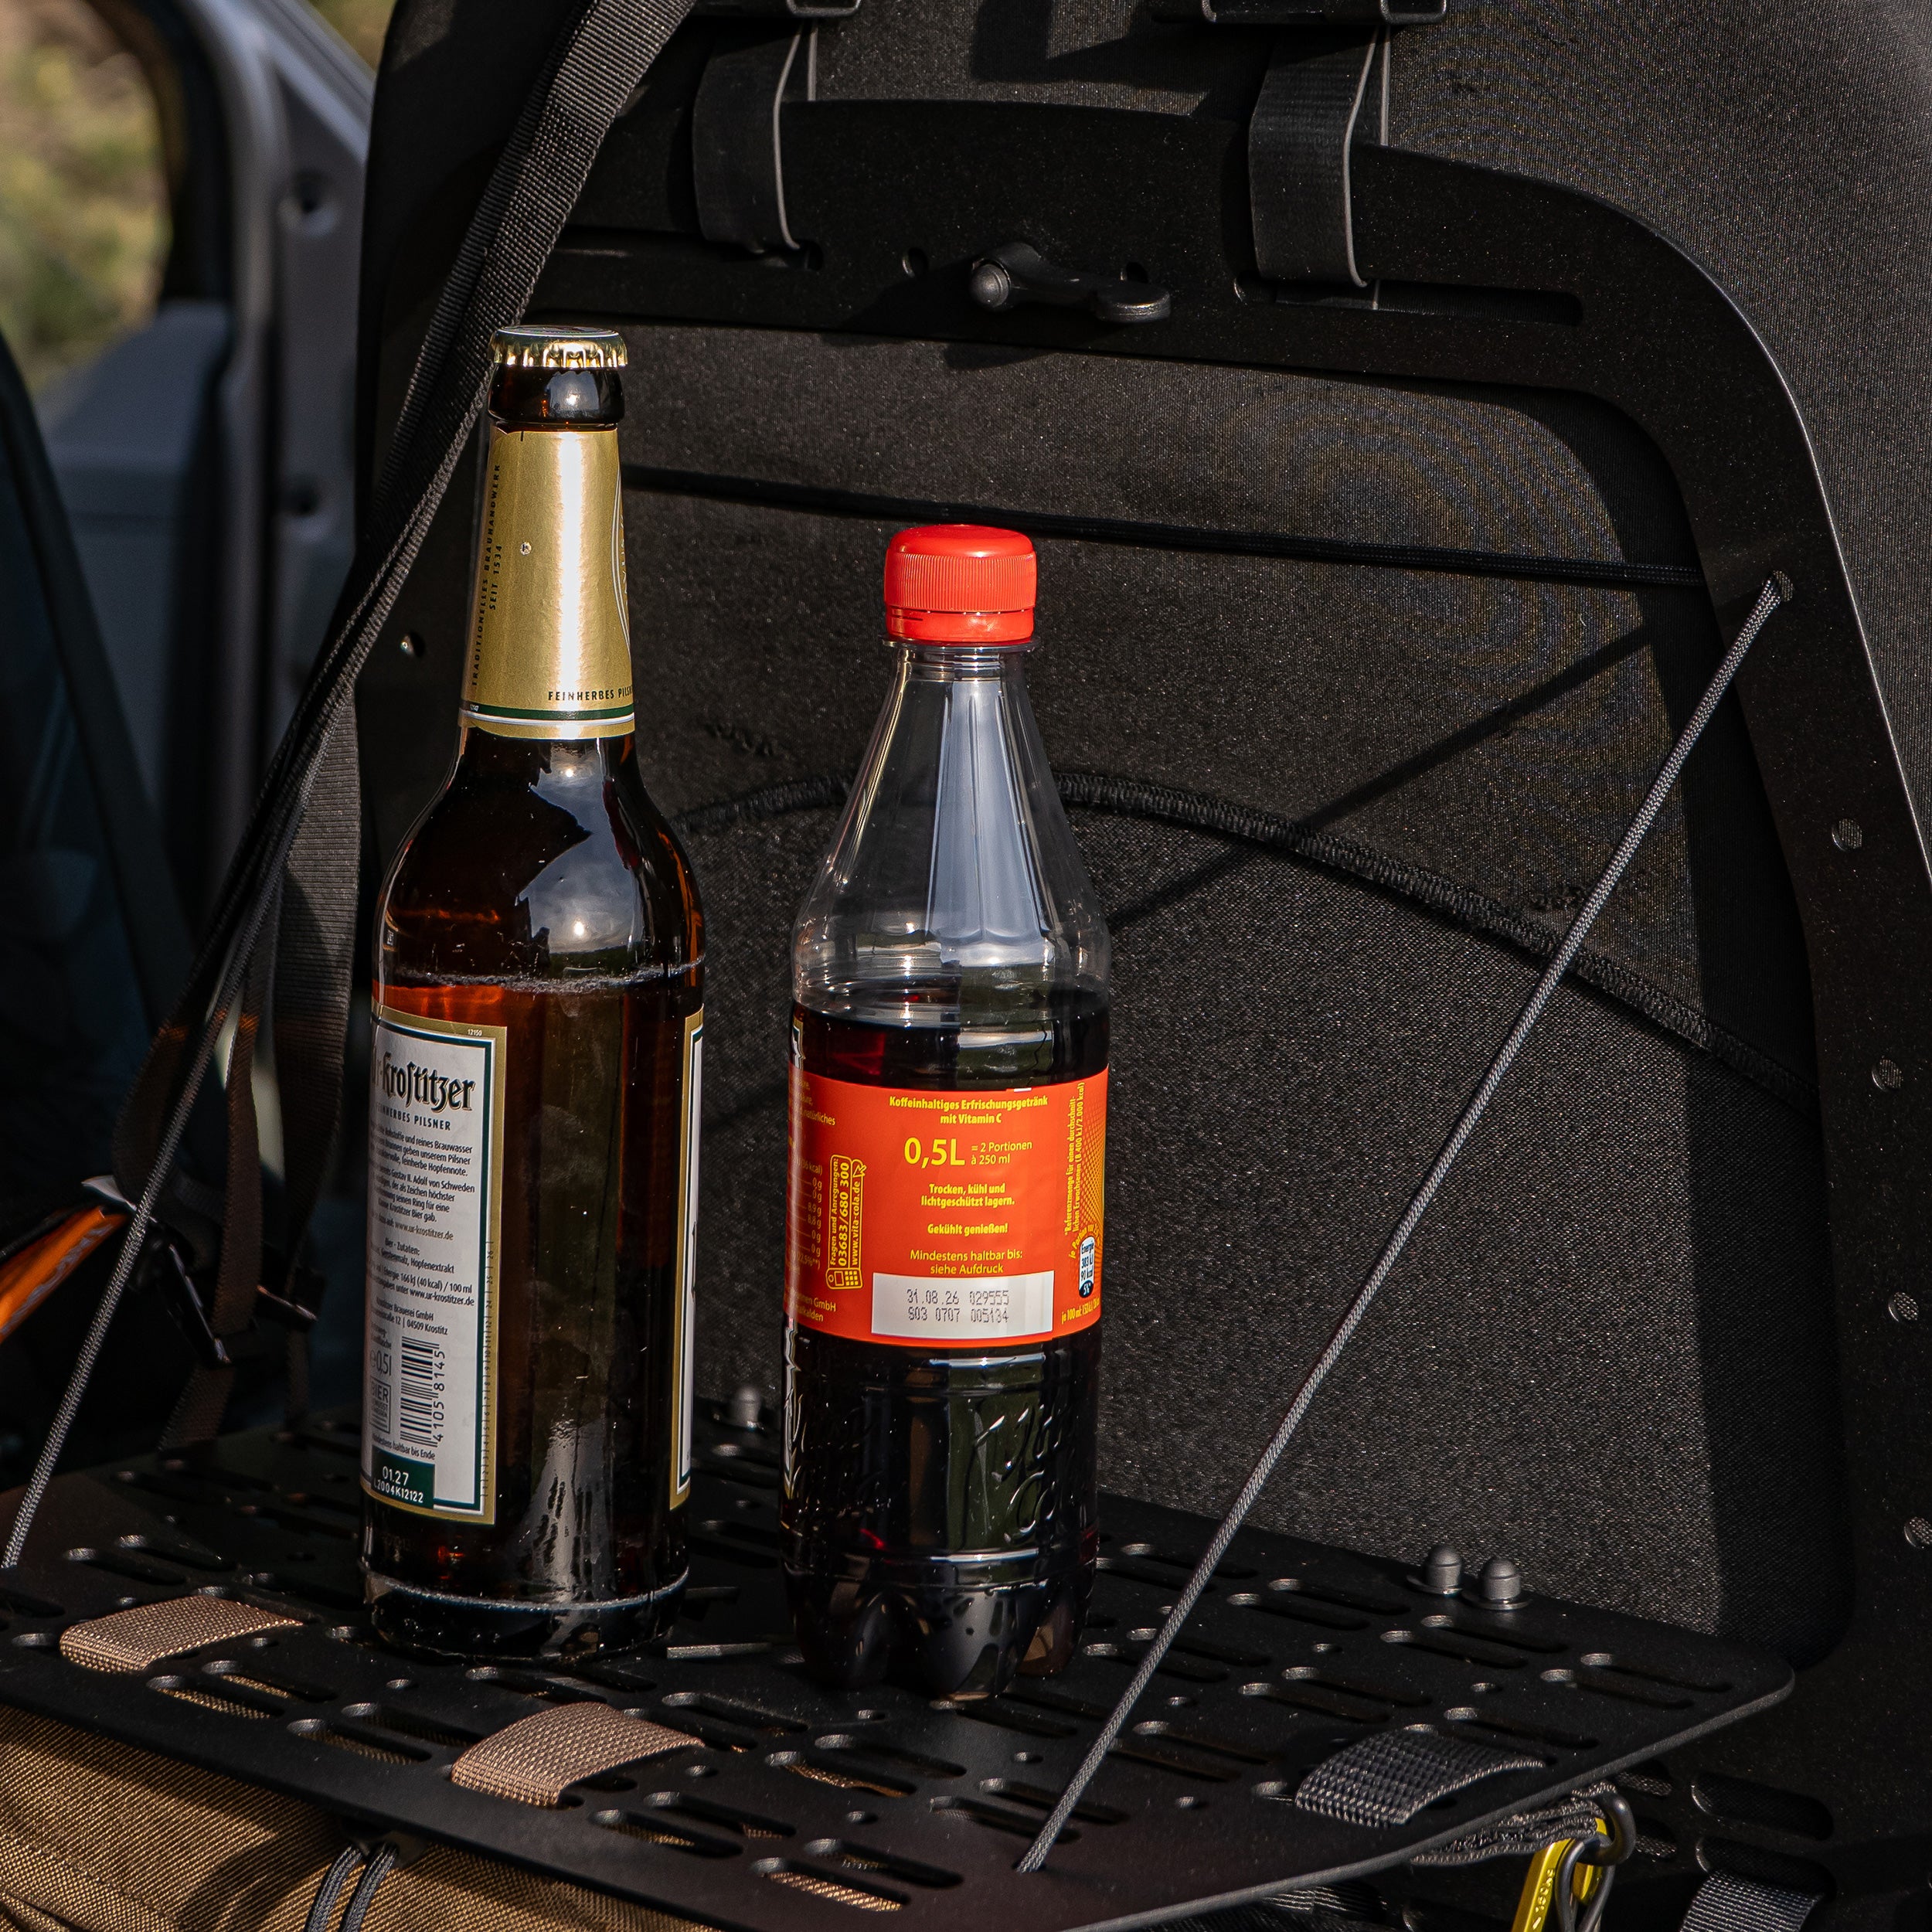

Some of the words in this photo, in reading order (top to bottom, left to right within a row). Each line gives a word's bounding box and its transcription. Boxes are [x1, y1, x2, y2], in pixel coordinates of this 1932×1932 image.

[493, 544, 502, 575] 1534
[472, 579, 488, 686] TRADITIONELLES
[484, 464, 500, 571] BRAUHANDWERK
[489, 583, 498, 611] SEIT
[548, 689, 614, 701] FEINHERBES
[889, 1096, 959, 1112] Koffeinhaltiges
[961, 1095, 1048, 1111] Erfrischungsgetränk
[413, 1115, 451, 1131] PILSNER
[940, 1114, 957, 1124] mit
[958, 1113, 995, 1124] Vitamin
[996, 1113, 1002, 1124] C
[405, 1134, 415, 1145] und
[416, 1137, 433, 1148] reines
[434, 1140, 473, 1154] Brauwasser
[980, 1142, 986, 1152] 2
[988, 1141, 1032, 1152] Portionen
[403, 1145, 420, 1157] geben
[420, 1150, 446, 1162] unserem
[448, 1154, 471, 1165] Pilsner
[903, 1137, 965, 1168] 0,5L
[971, 1155, 977, 1165] à
[978, 1155, 997, 1165] 250
[998, 1154, 1010, 1165] ml
[402, 1153, 427, 1170] feinherbe
[428, 1163, 468, 1176] Hopfennote.
[1066, 1163, 1074, 1175] für
[840, 1162, 849, 1188] 300
[413, 1175, 427, 1186] Adolf
[429, 1180, 440, 1189] von
[441, 1180, 474, 1193] Schweden
[818, 1181, 821, 1191] g
[831, 1158, 840, 1215] Anregungen:
[929, 1184, 967, 1196] Trocken,
[968, 1184, 988, 1194] kühl
[989, 1183, 1005, 1193] und
[406, 1184, 427, 1197] Zeichen
[428, 1189, 455, 1202] höchster
[818, 1193, 821, 1203] g
[396, 1193, 411, 1205] seinen
[412, 1198, 425, 1210] Ring
[426, 1199, 434, 1209] für
[436, 1203, 450, 1213] eine
[921, 1196, 984, 1209] lichtgeschützt
[985, 1196, 1015, 1208] lagern.
[411, 1209, 423, 1219] Bier
[423, 1213, 437, 1223] gab.
[817, 1207, 821, 1217] g
[395, 1221, 454, 1240] www.ur-krostitzer.de
[817, 1219, 821, 1230] g
[838, 1192, 849, 1267] 03683/680
[852, 1181, 860, 1266] www.vita-cola.de
[927, 1224, 962, 1234] Gekühlt
[964, 1223, 1009, 1237] genießen!
[816, 1233, 821, 1243] g
[397, 1241, 420, 1256] Zutaten:
[816, 1247, 821, 1257] g
[910, 1249, 968, 1261] Mindestens
[970, 1250, 1005, 1260] haltbar
[1007, 1249, 1022, 1260] bis:
[410, 1257, 454, 1274] Hopfenextrakt
[930, 1264, 957, 1274] siehe
[959, 1263, 1004, 1274] Aufdruck
[417, 1277, 427, 1287] (40
[427, 1277, 443, 1292] kcal)
[449, 1283, 461, 1293] 100
[462, 1284, 472, 1294] ml
[410, 1288, 474, 1306] www.ur-krostitzer.de
[814, 1297, 836, 1312] GmbH
[969, 1290, 1009, 1305] 029555
[415, 1310, 434, 1321] GmbH
[936, 1307, 961, 1322] 0707
[971, 1308, 1009, 1323] 005134
[1061, 1311, 1066, 1325] je
[1067, 1308, 1076, 1321] 100
[395, 1315, 401, 1325] 12
[406, 1320, 423, 1331] 04509
[424, 1323, 448, 1335] Krostitz
[434, 1350, 445, 1392] 8145
[433, 1401, 444, 1442] 4105
[410, 1447, 420, 1458] bis
[420, 1448, 435, 1461] Ende
[382, 1466, 409, 1486] 01.27
